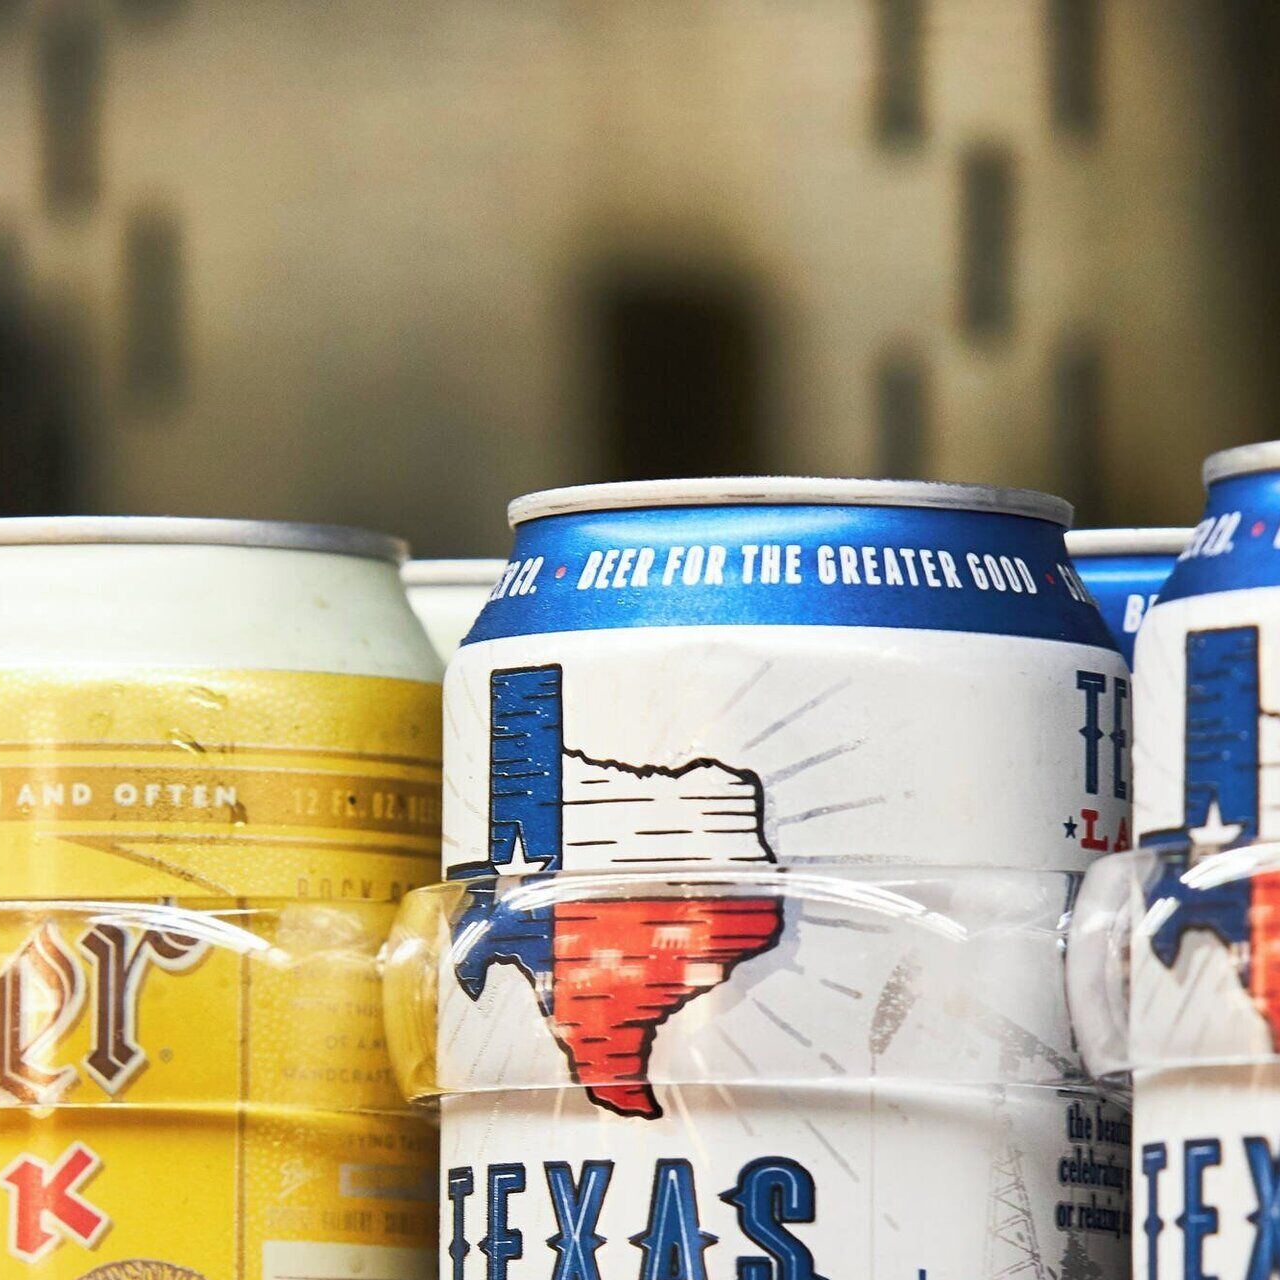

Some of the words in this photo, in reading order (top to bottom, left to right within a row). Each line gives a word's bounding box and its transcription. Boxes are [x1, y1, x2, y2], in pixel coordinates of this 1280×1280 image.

[577, 547, 655, 590] BEER
[662, 545, 727, 586] FOR
[742, 544, 802, 584] THE
[817, 545, 963, 588] GREATER
[966, 552, 1038, 594] GOOD
[16, 783, 94, 807] AND
[114, 783, 237, 808] OFTEN
